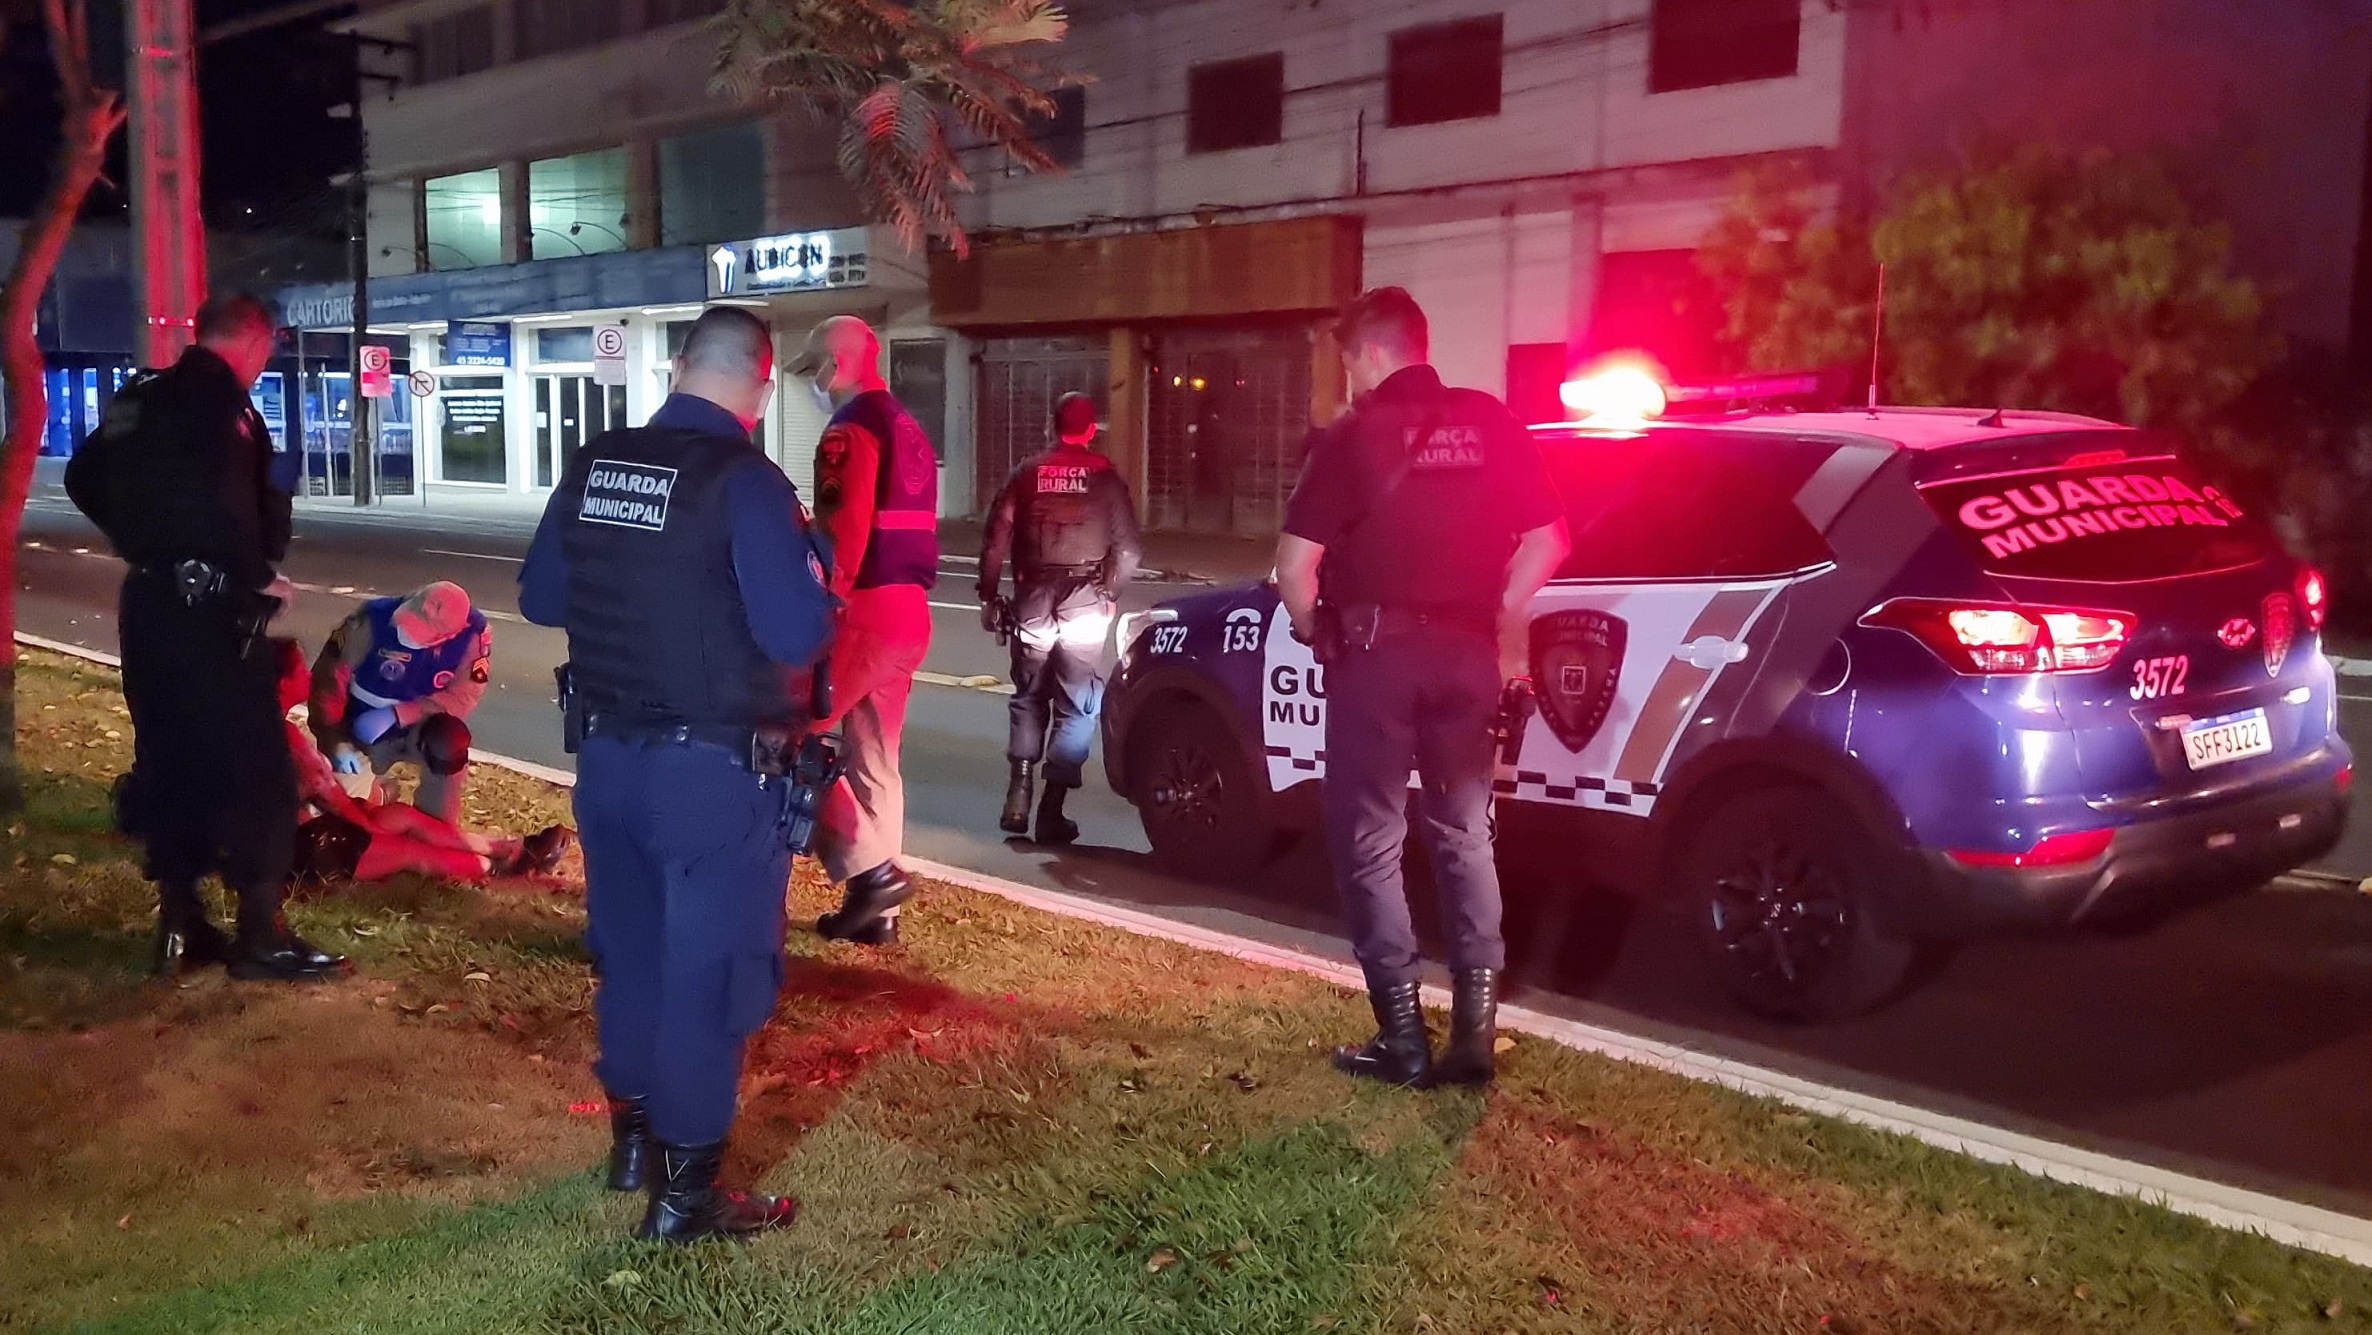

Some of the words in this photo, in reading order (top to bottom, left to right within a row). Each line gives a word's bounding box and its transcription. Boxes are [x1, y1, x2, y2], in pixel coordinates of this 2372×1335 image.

[605, 335, 614, 349] E
[371, 354, 380, 366] E
[1406, 429, 1479, 447] FRÇA
[589, 470, 668, 497] GUARDA
[1040, 478, 1087, 491] RURAL
[583, 497, 662, 525] MUNICIPAL
[1959, 475, 2204, 530] GUARDA
[1981, 505, 2228, 559] MUNICIPAL
[1150, 625, 1188, 653] 3572
[1222, 625, 1260, 653] 153
[2129, 655, 2188, 700] 3572
[2192, 722, 2261, 760] SFF3122
